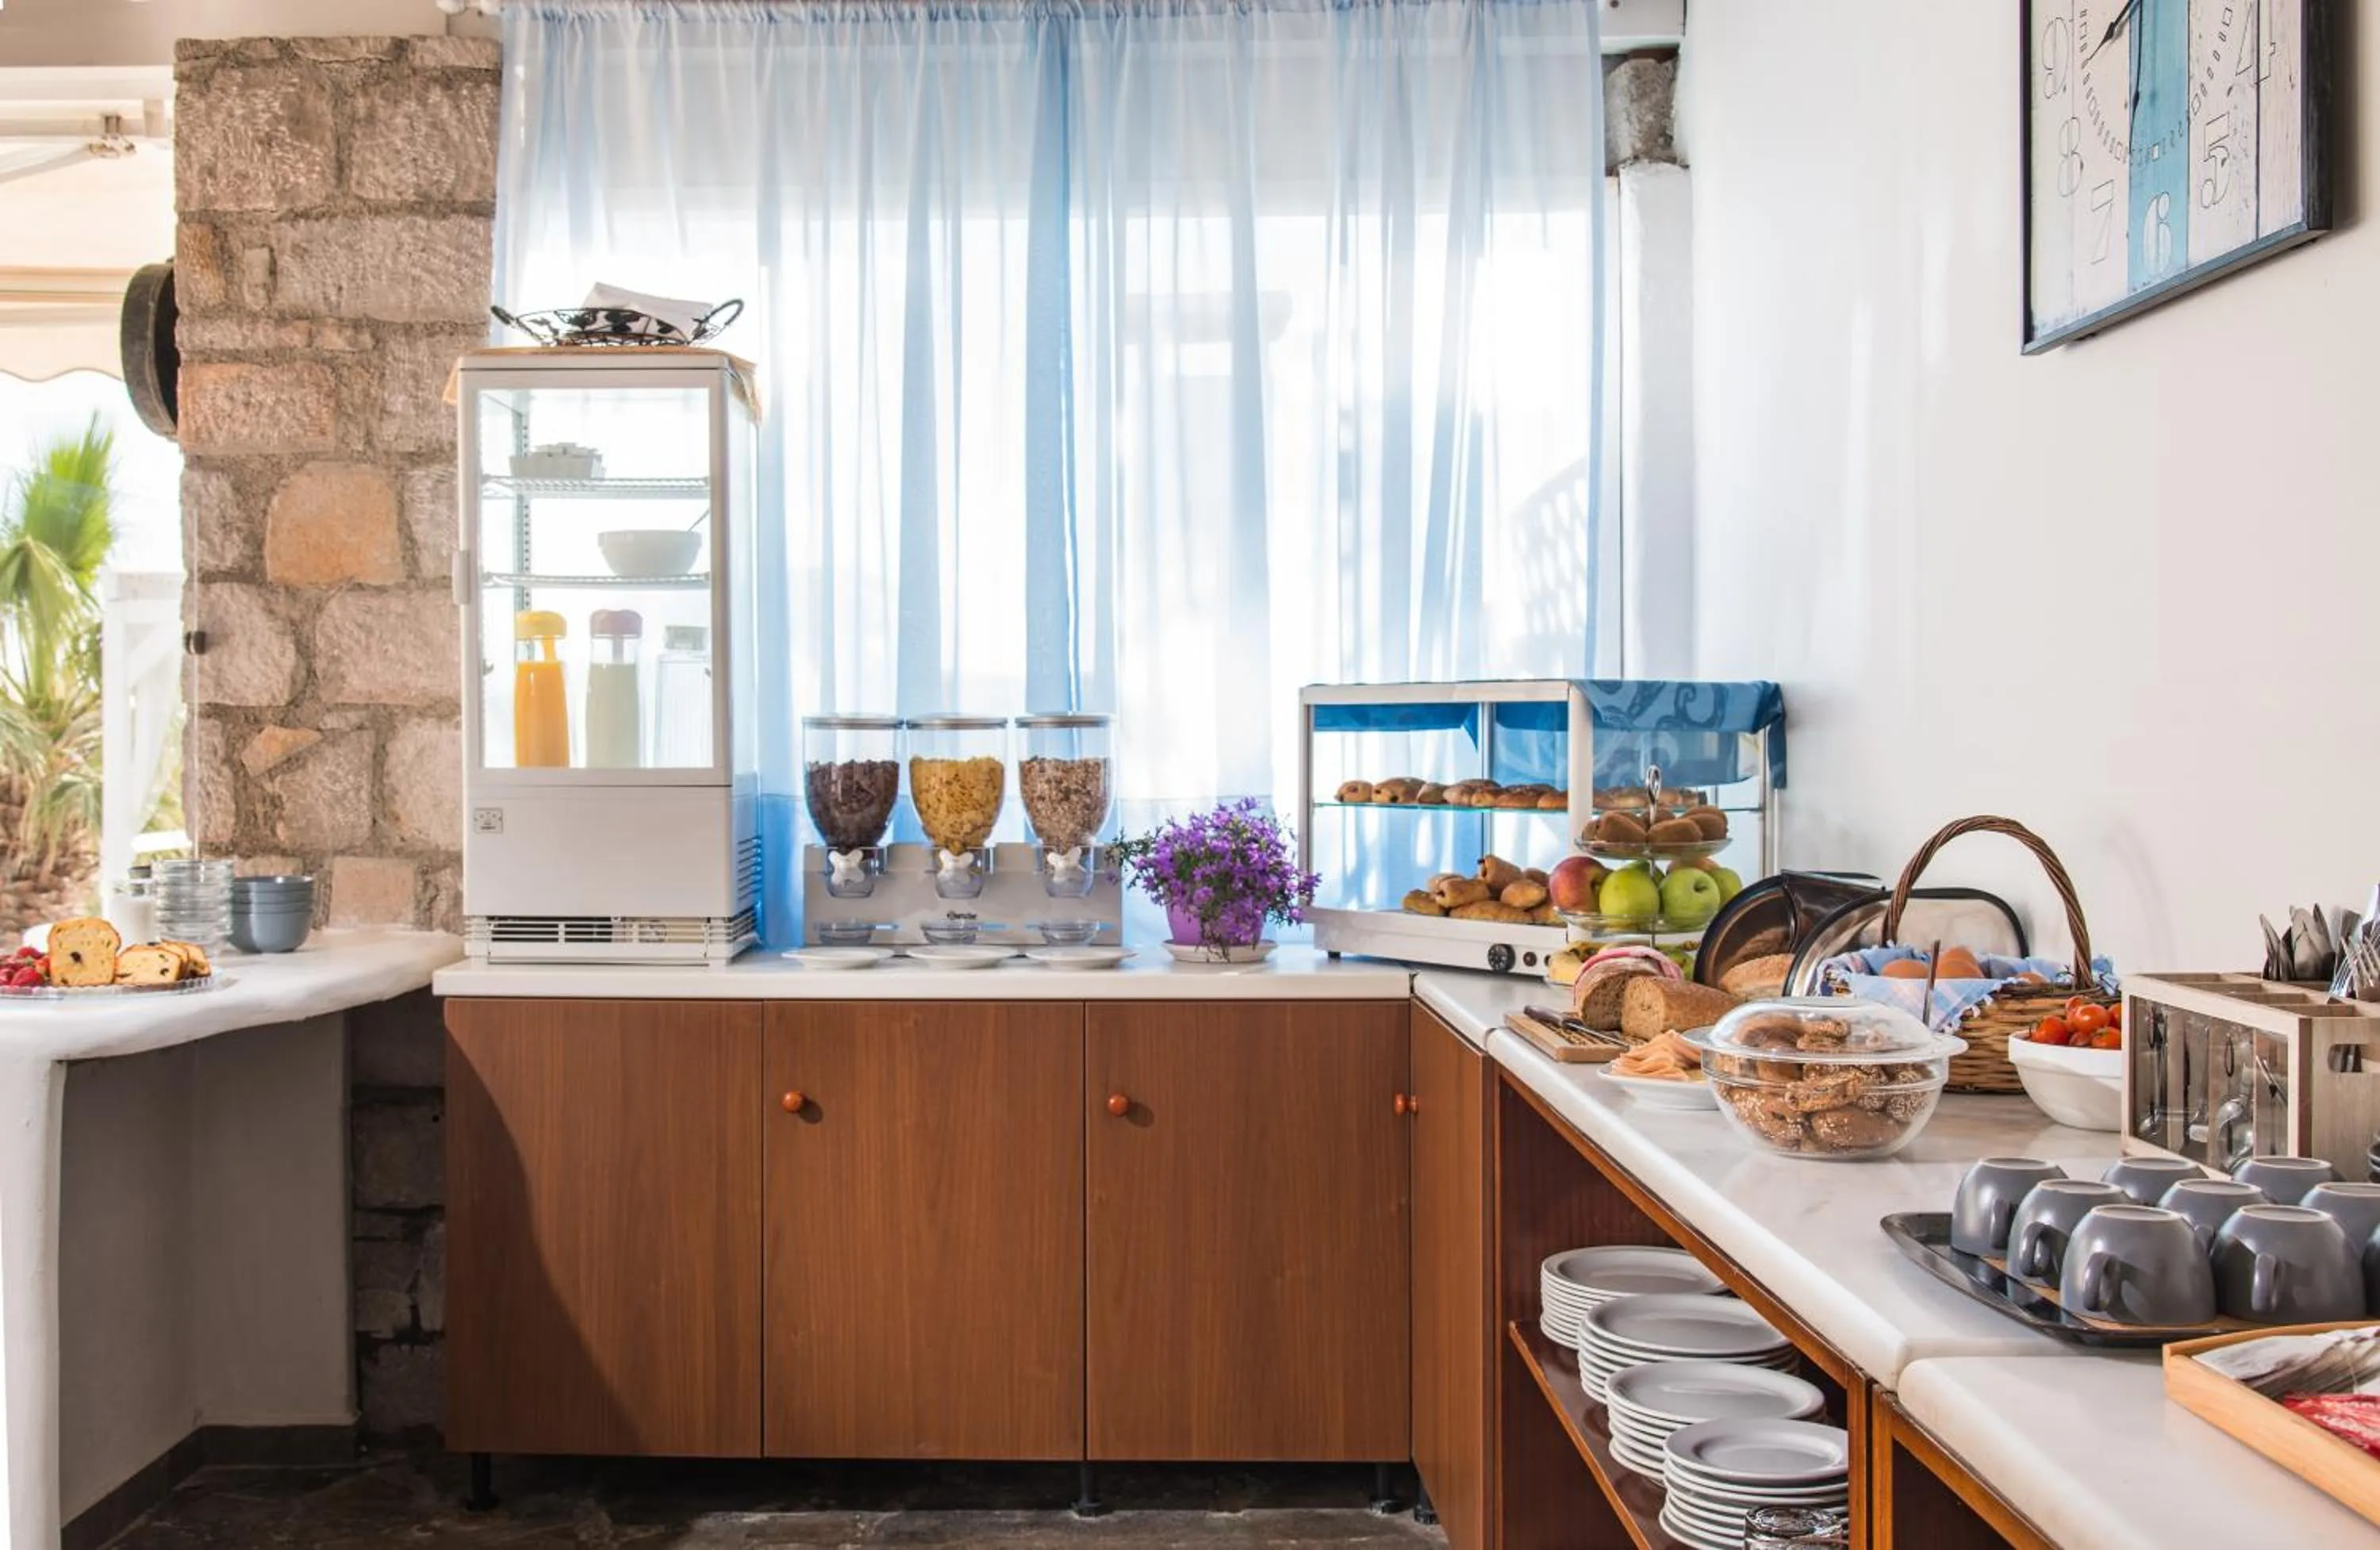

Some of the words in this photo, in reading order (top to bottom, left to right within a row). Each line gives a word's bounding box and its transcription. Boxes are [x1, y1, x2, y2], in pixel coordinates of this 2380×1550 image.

[2041, 16, 2069, 99] 9
[2058, 117, 2084, 198] 8
[2200, 110, 2229, 209] 5
[2090, 179, 2115, 266] 7
[2143, 190, 2171, 274] 6
